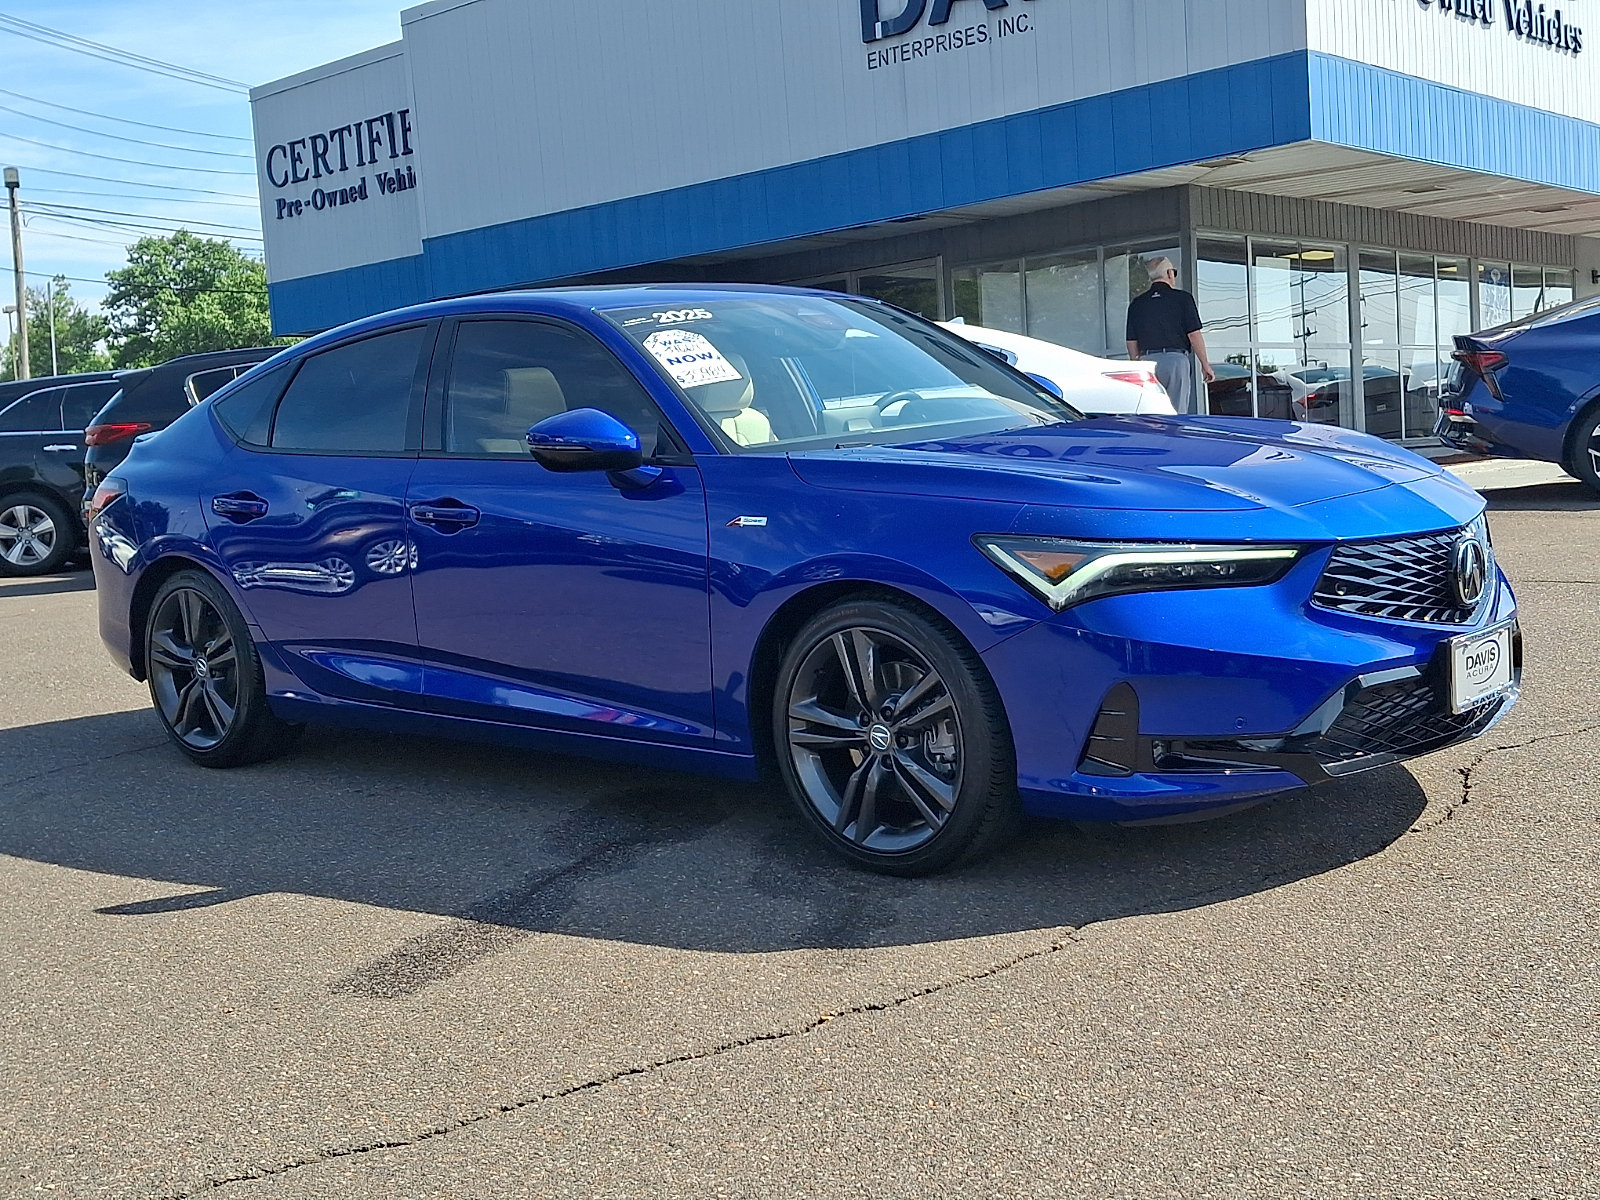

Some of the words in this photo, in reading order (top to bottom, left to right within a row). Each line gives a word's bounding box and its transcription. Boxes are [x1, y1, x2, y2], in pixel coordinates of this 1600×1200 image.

[1501, 0, 1582, 54] Vehicles
[867, 24, 993, 70] ENTERPRISES,
[997, 13, 1034, 38] INC.
[275, 177, 369, 220] Pre-Owned
[375, 165, 417, 195] Vehi
[652, 308, 712, 323] 2025
[666, 351, 713, 366] NOW
[1465, 646, 1495, 671] DAVIS
[1466, 663, 1494, 679] ACURA
